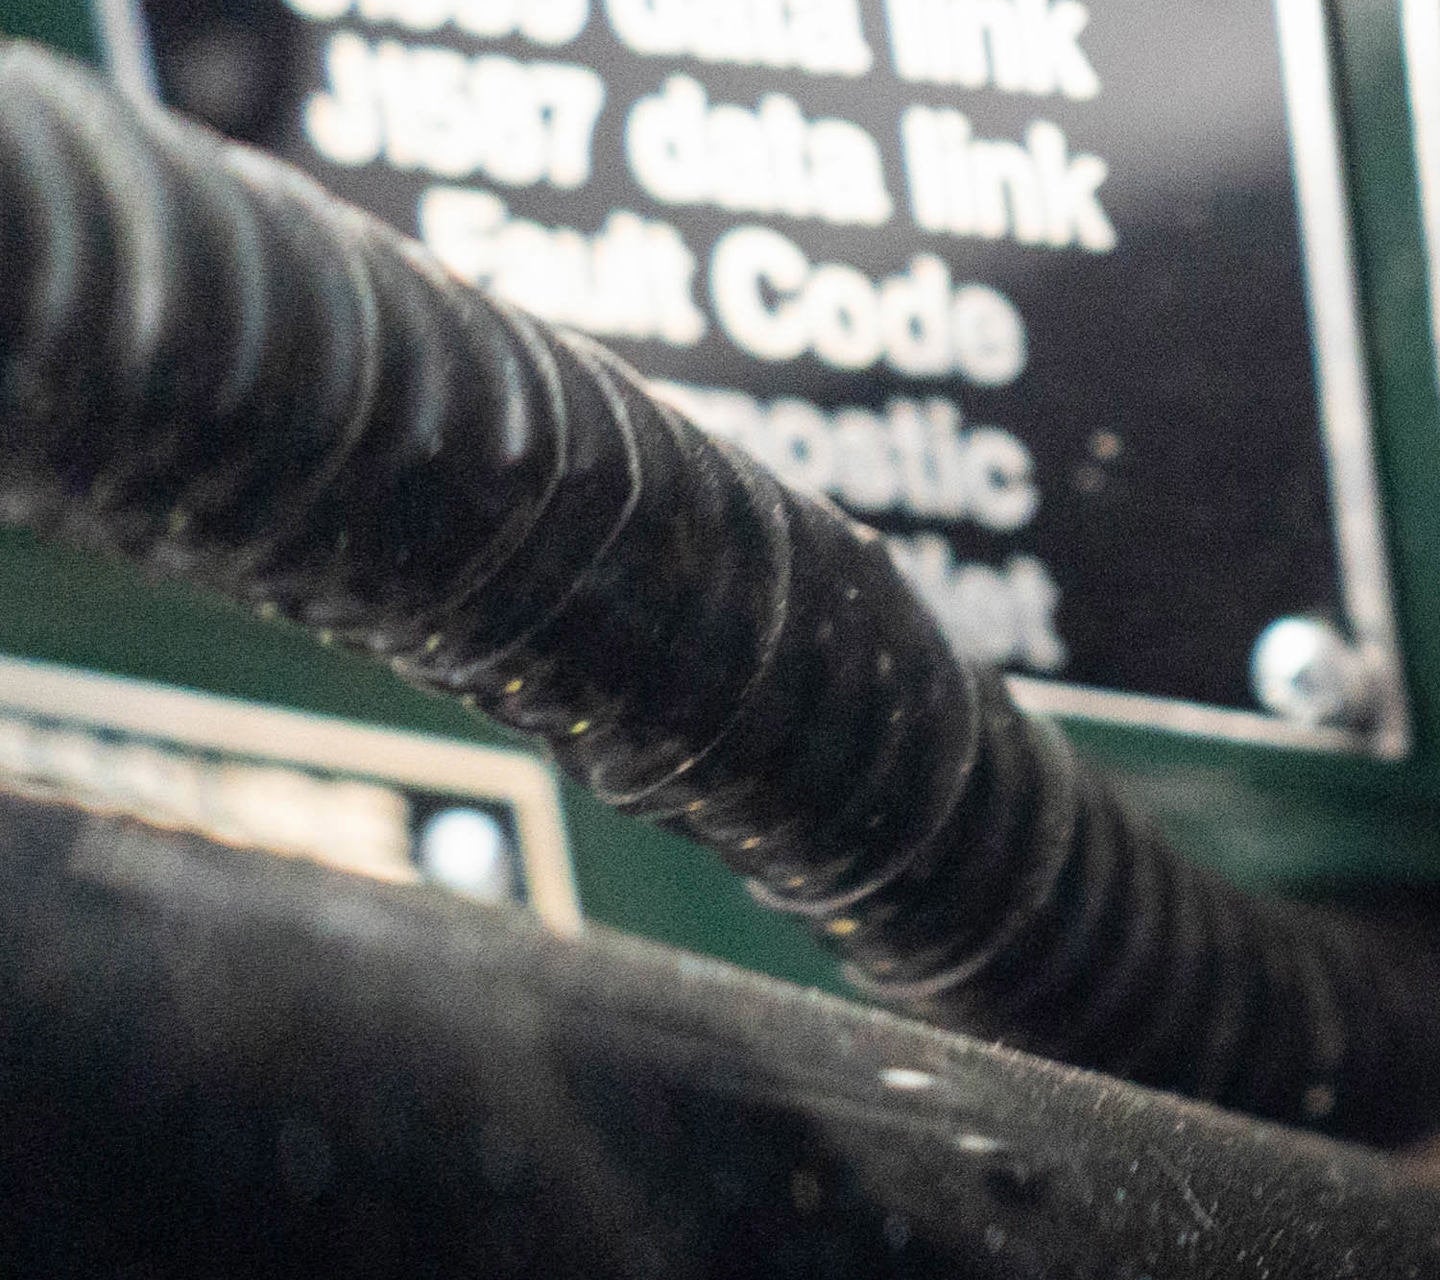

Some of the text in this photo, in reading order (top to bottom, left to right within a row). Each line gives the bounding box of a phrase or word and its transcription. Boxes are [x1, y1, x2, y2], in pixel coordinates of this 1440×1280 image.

[625, 71, 892, 226] data
[900, 104, 1115, 252] link
[708, 226, 1027, 387] Code
